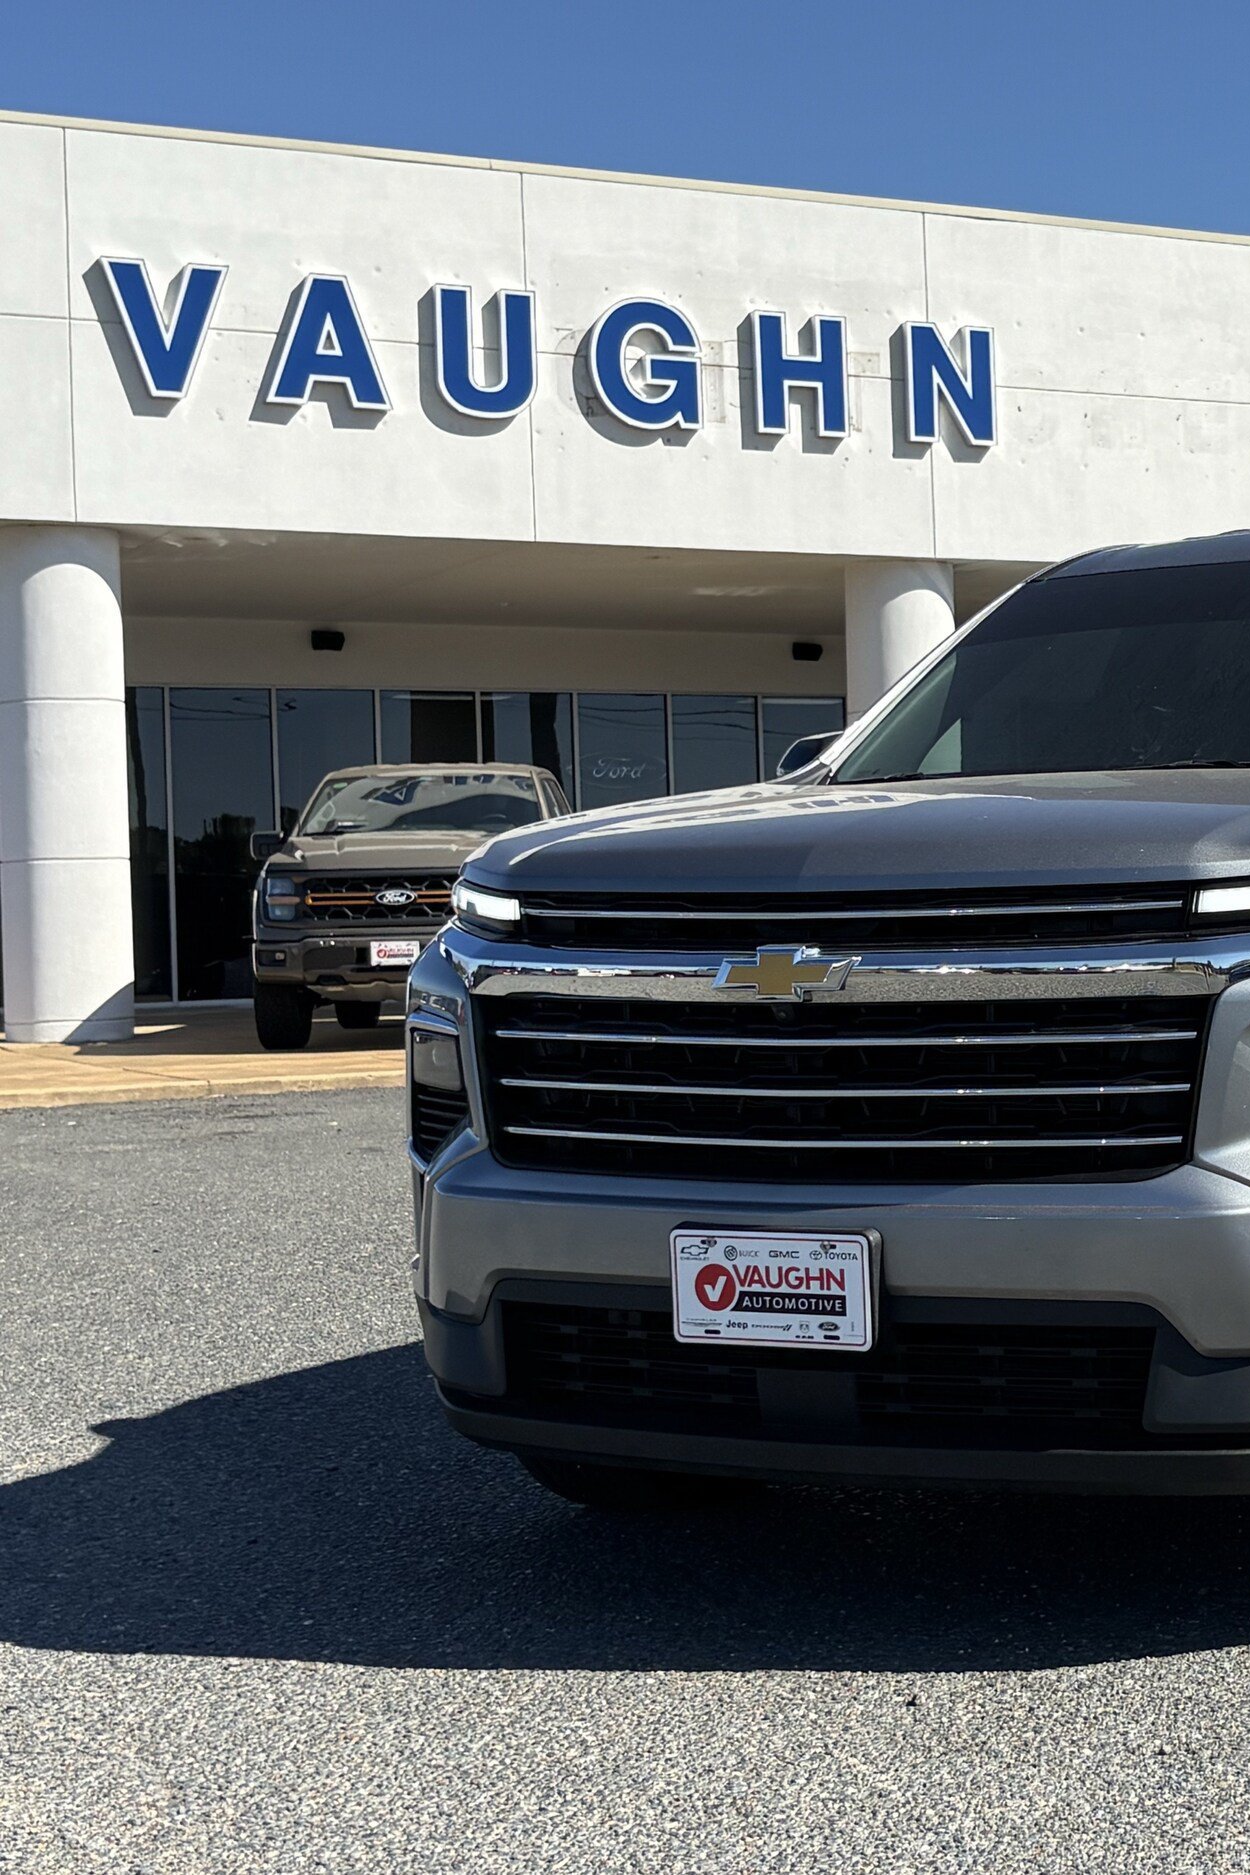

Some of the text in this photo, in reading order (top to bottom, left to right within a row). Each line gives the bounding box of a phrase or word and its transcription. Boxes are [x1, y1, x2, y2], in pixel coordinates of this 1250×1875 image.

[98, 256, 999, 447] VAUGHN
[592, 756, 647, 779] Ford
[768, 1250, 800, 1259] GMC
[824, 1252, 858, 1261] TOYOTA
[732, 1264, 846, 1292] VAUGHN
[742, 1296, 844, 1312] AUTOMOTIVE
[726, 1319, 748, 1329] Jeep
